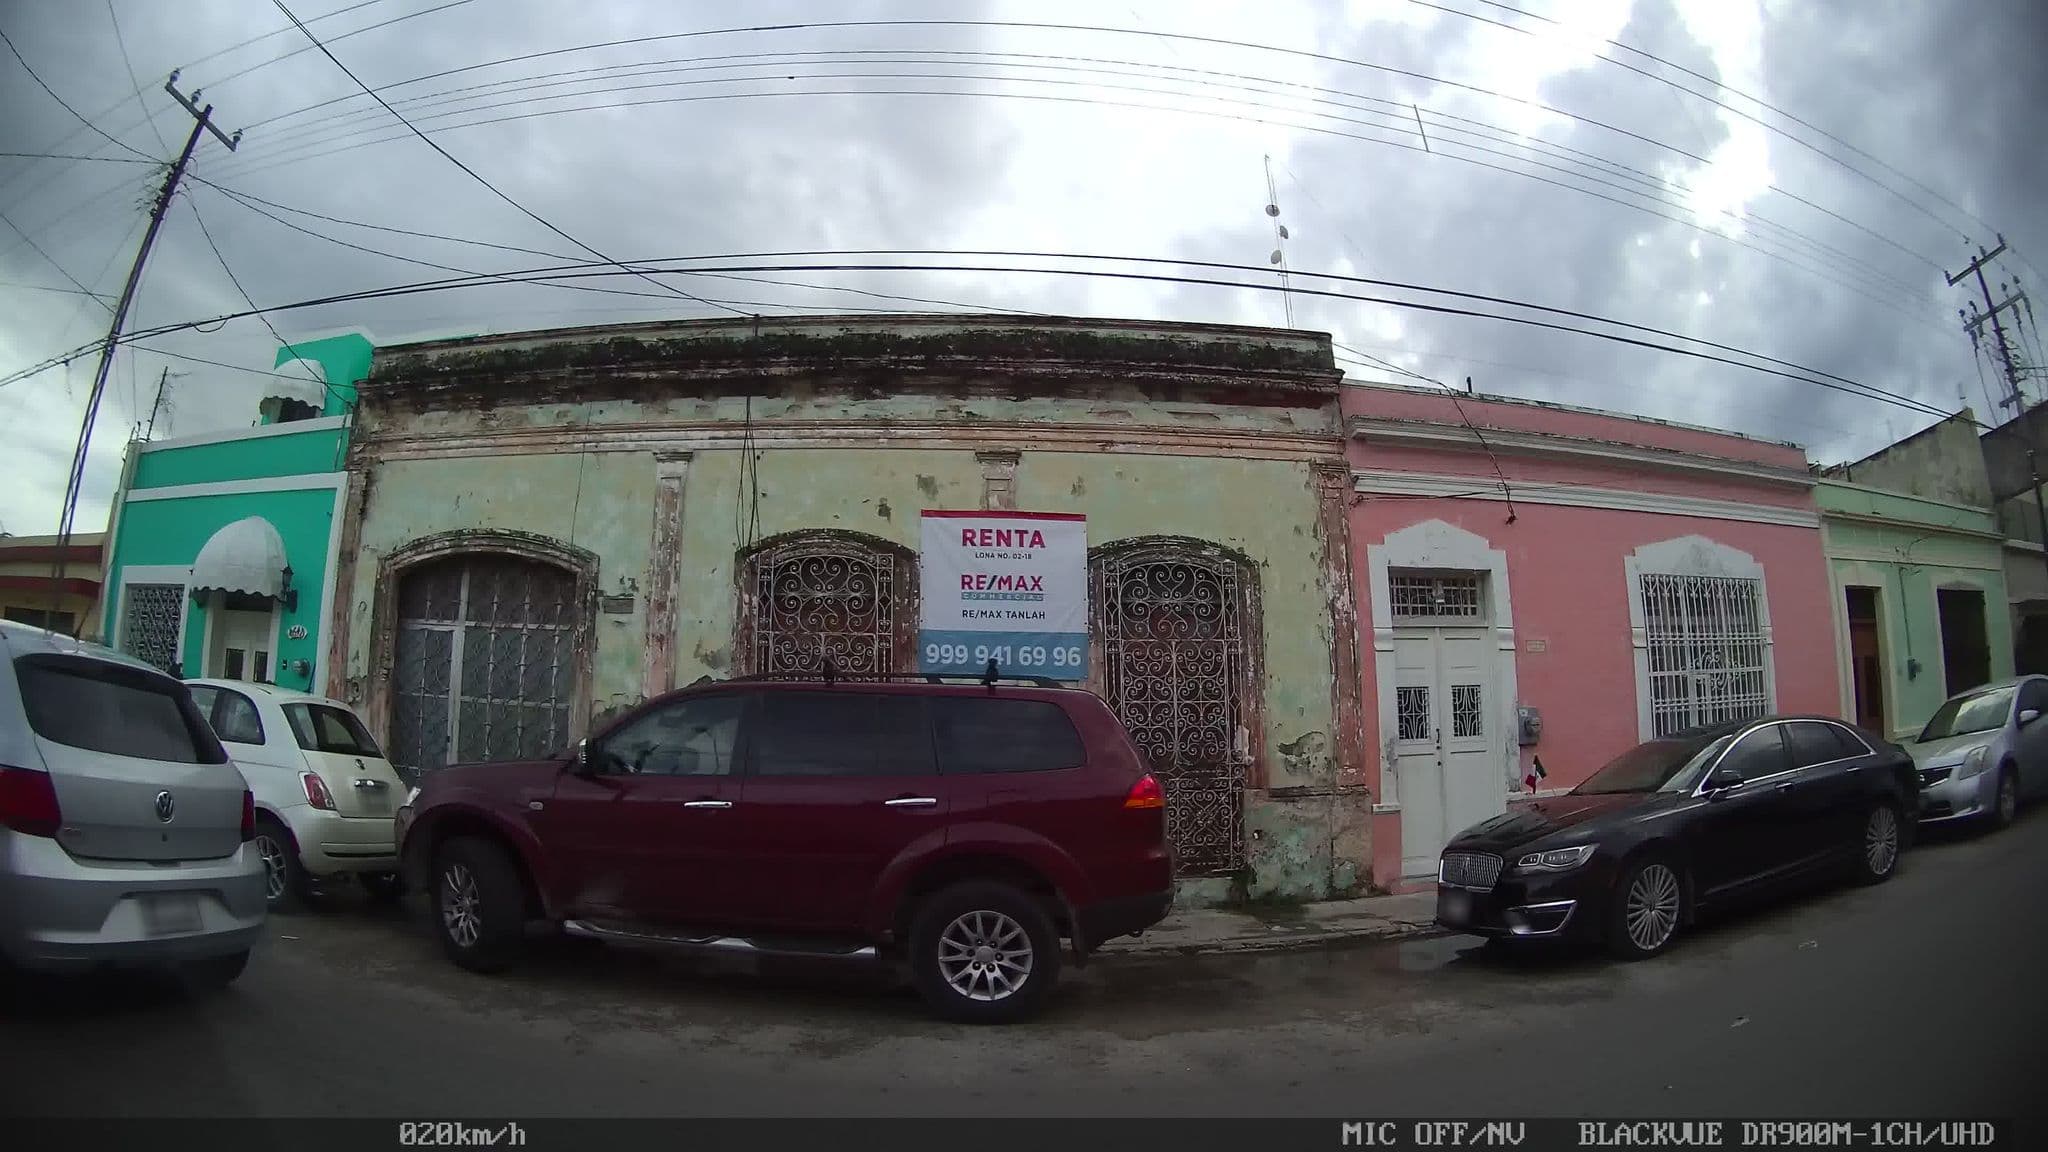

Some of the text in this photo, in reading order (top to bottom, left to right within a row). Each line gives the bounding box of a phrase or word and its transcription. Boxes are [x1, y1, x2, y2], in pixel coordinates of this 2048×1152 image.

[962, 528, 1046, 549] RENTA
[975, 551, 995, 559] LONA
[997, 552, 1011, 560] NO.
[960, 574, 1044, 592] RE/MAX
[962, 609, 1046, 620] RE/MAX TANLAH
[926, 643, 1082, 667] 999 941 69 96
